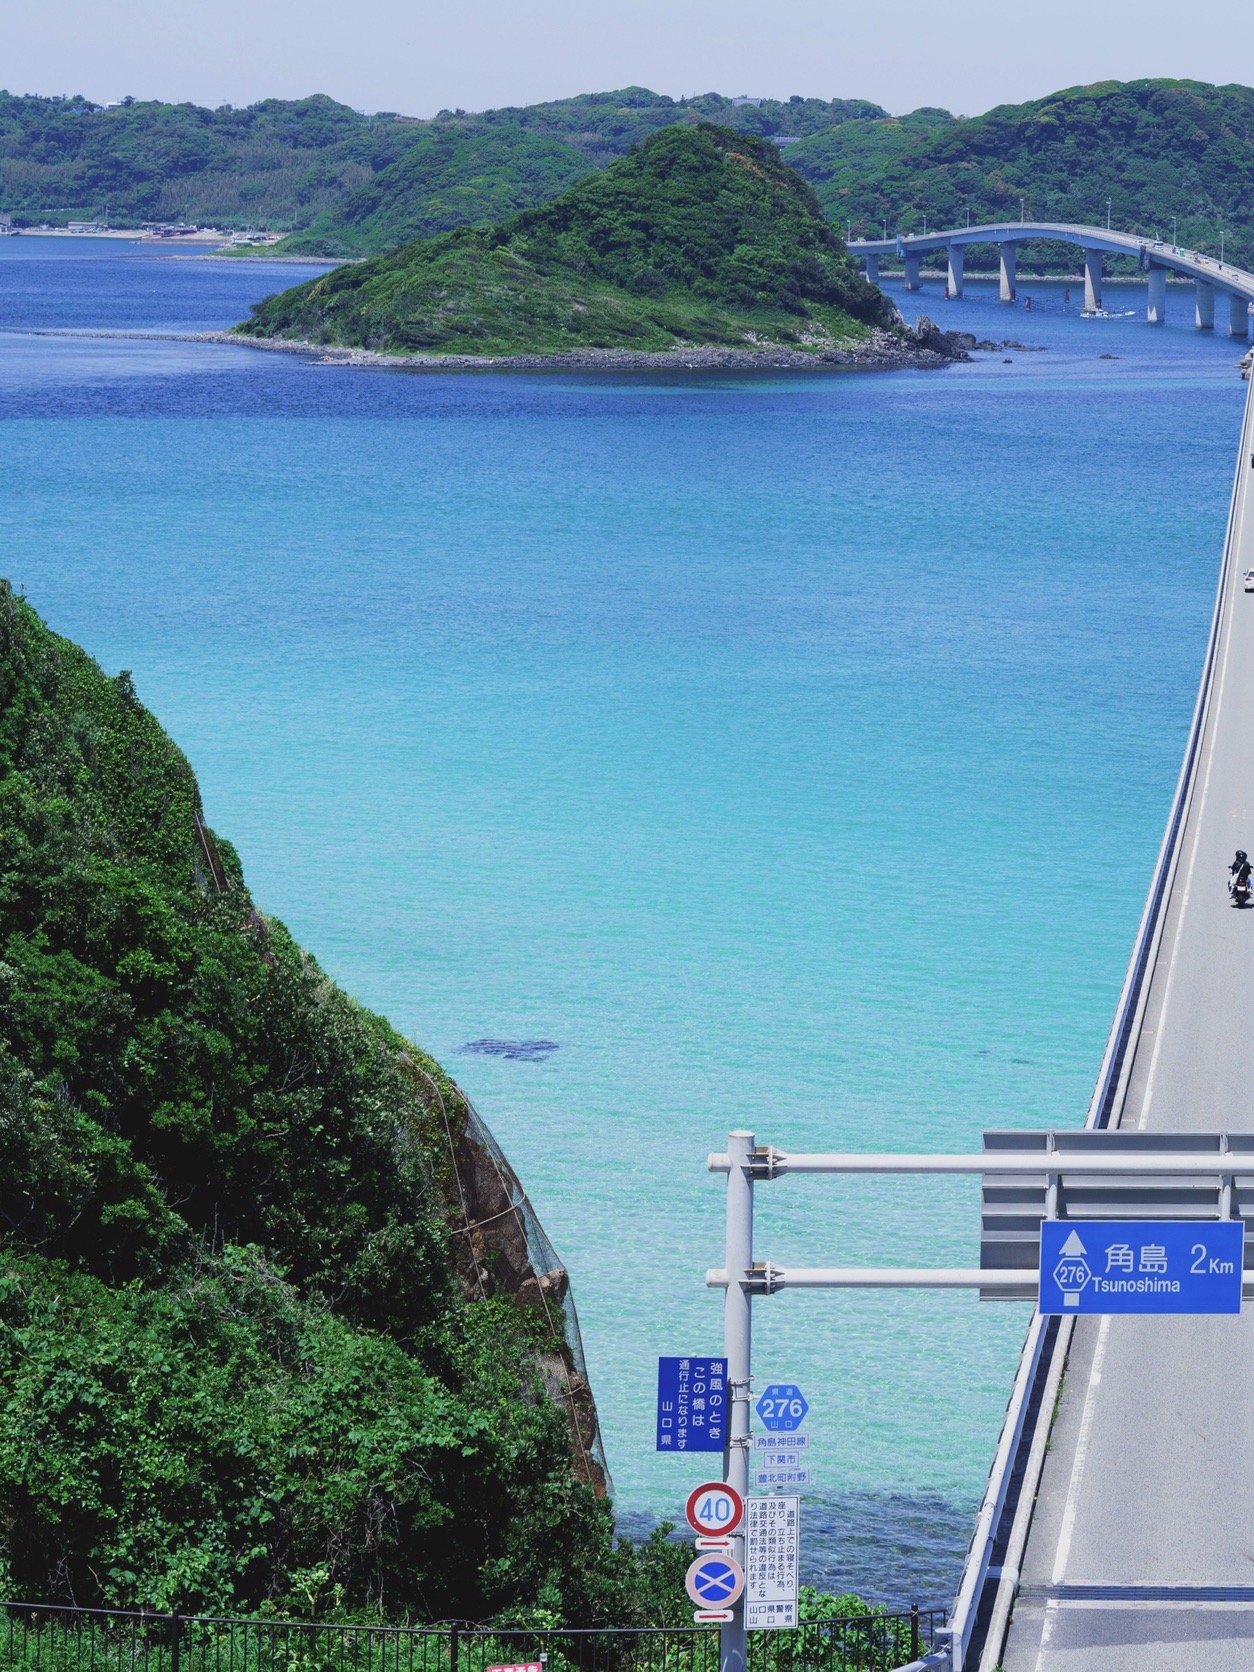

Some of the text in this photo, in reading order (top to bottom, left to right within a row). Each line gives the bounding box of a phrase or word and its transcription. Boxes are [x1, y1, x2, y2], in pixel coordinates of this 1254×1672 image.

[1104, 1243, 1168, 1274] 角島
[1059, 1266, 1085, 1283] 276
[1091, 1276, 1181, 1293] Tsunoshima
[692, 1366, 706, 1427] この橋は
[771, 1387, 793, 1396] 県道
[677, 1359, 690, 1449] 通行止になります
[708, 1362, 723, 1439] 強風のとき
[762, 1398, 803, 1418] 276
[661, 1400, 673, 1445] 山口県
[770, 1420, 793, 1429] 山口
[757, 1436, 806, 1448] 角島神田線
[767, 1454, 796, 1465] 下関市
[699, 1497, 730, 1522] 40
[749, 1604, 793, 1614] 山口県警察
[749, 1614, 793, 1625] 山口県
